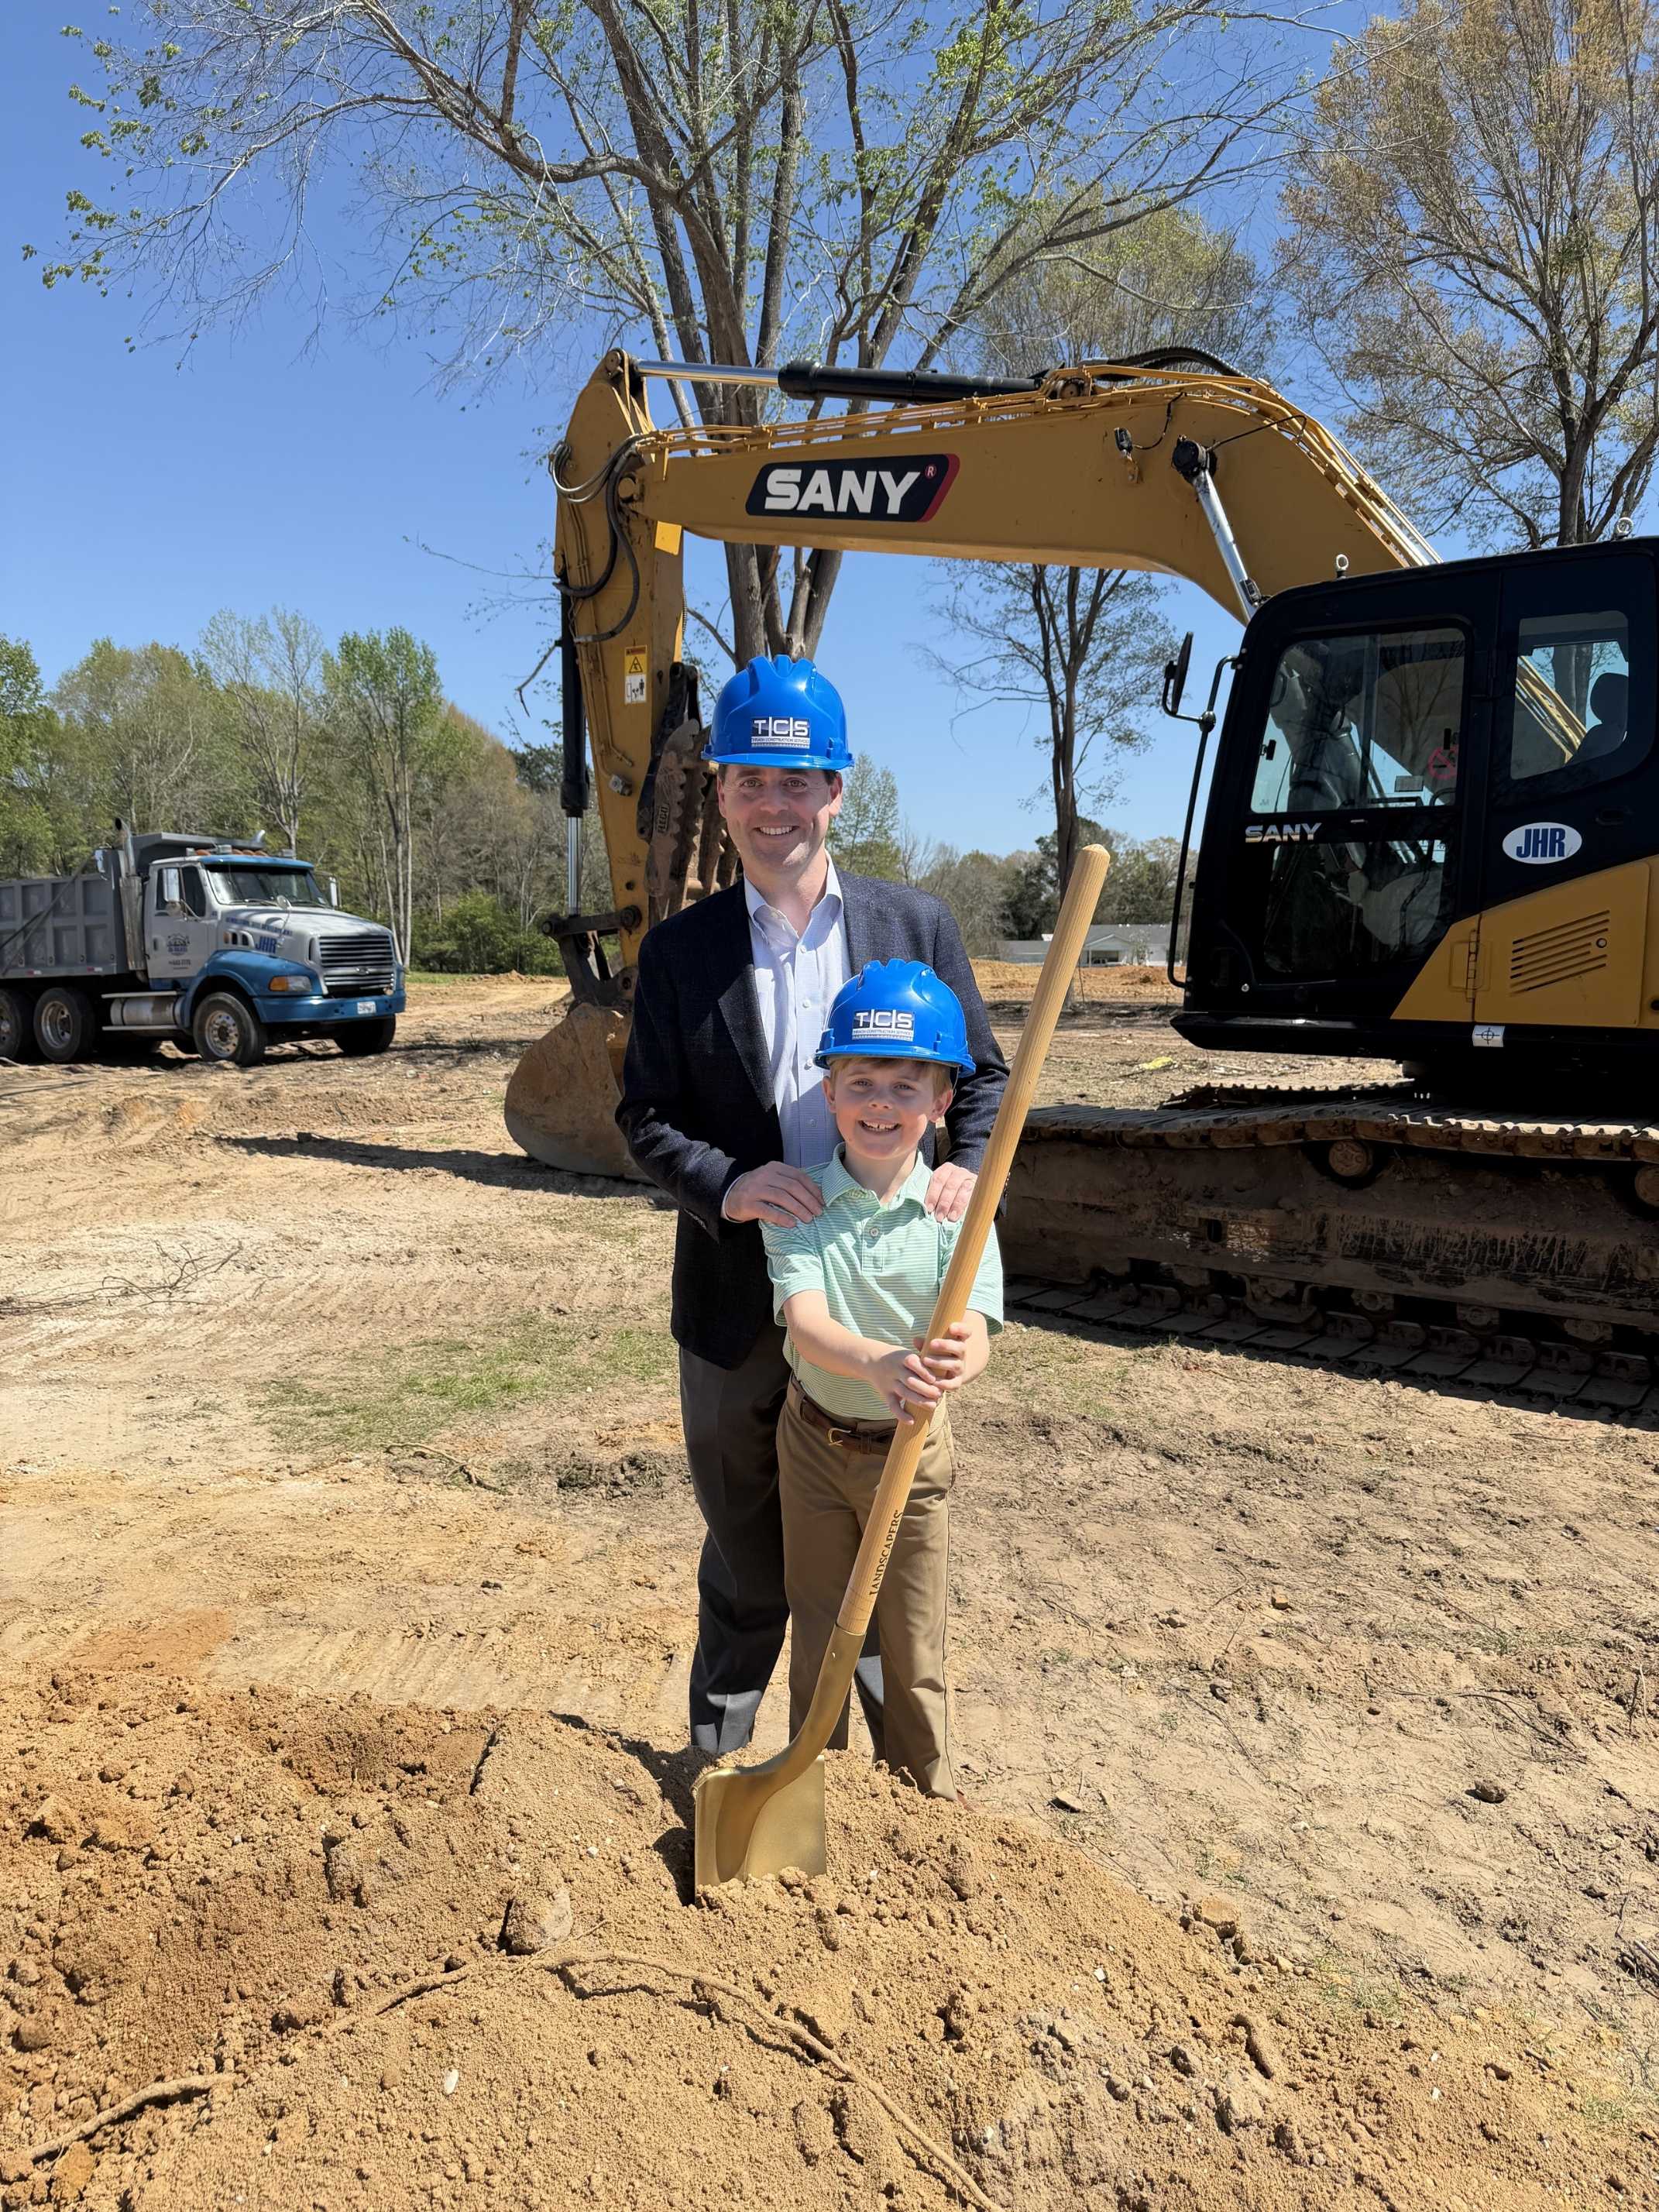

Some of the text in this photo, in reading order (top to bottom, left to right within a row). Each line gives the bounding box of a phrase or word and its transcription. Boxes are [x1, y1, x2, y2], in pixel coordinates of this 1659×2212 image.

[764, 469, 921, 514] SANY
[1245, 823, 1322, 843] SANY
[1516, 827, 1566, 858] JHR
[255, 936, 276, 954] JHR
